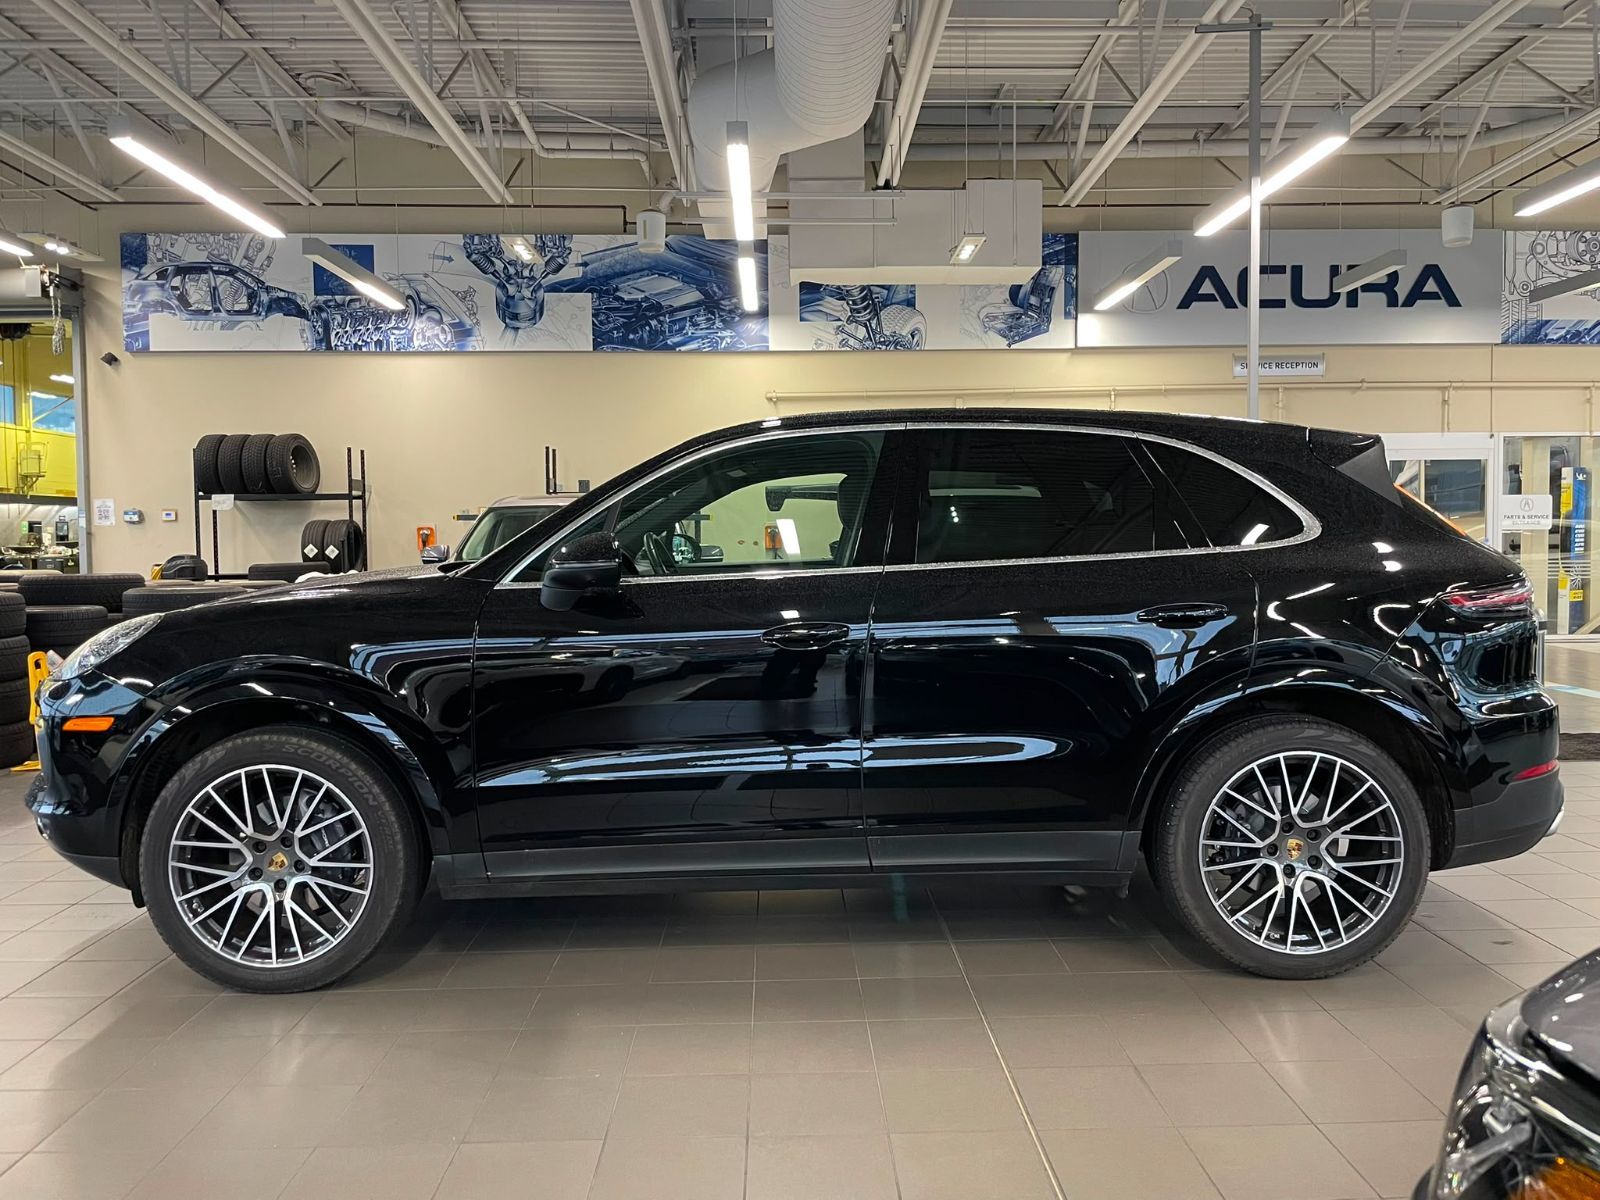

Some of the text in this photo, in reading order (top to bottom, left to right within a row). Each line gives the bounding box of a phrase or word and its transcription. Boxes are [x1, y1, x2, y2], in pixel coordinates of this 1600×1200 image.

[1176, 264, 1463, 309] ACURA
[1240, 361, 1319, 370] SICE RECEPTION
[282, 744, 378, 806] SCORPION
